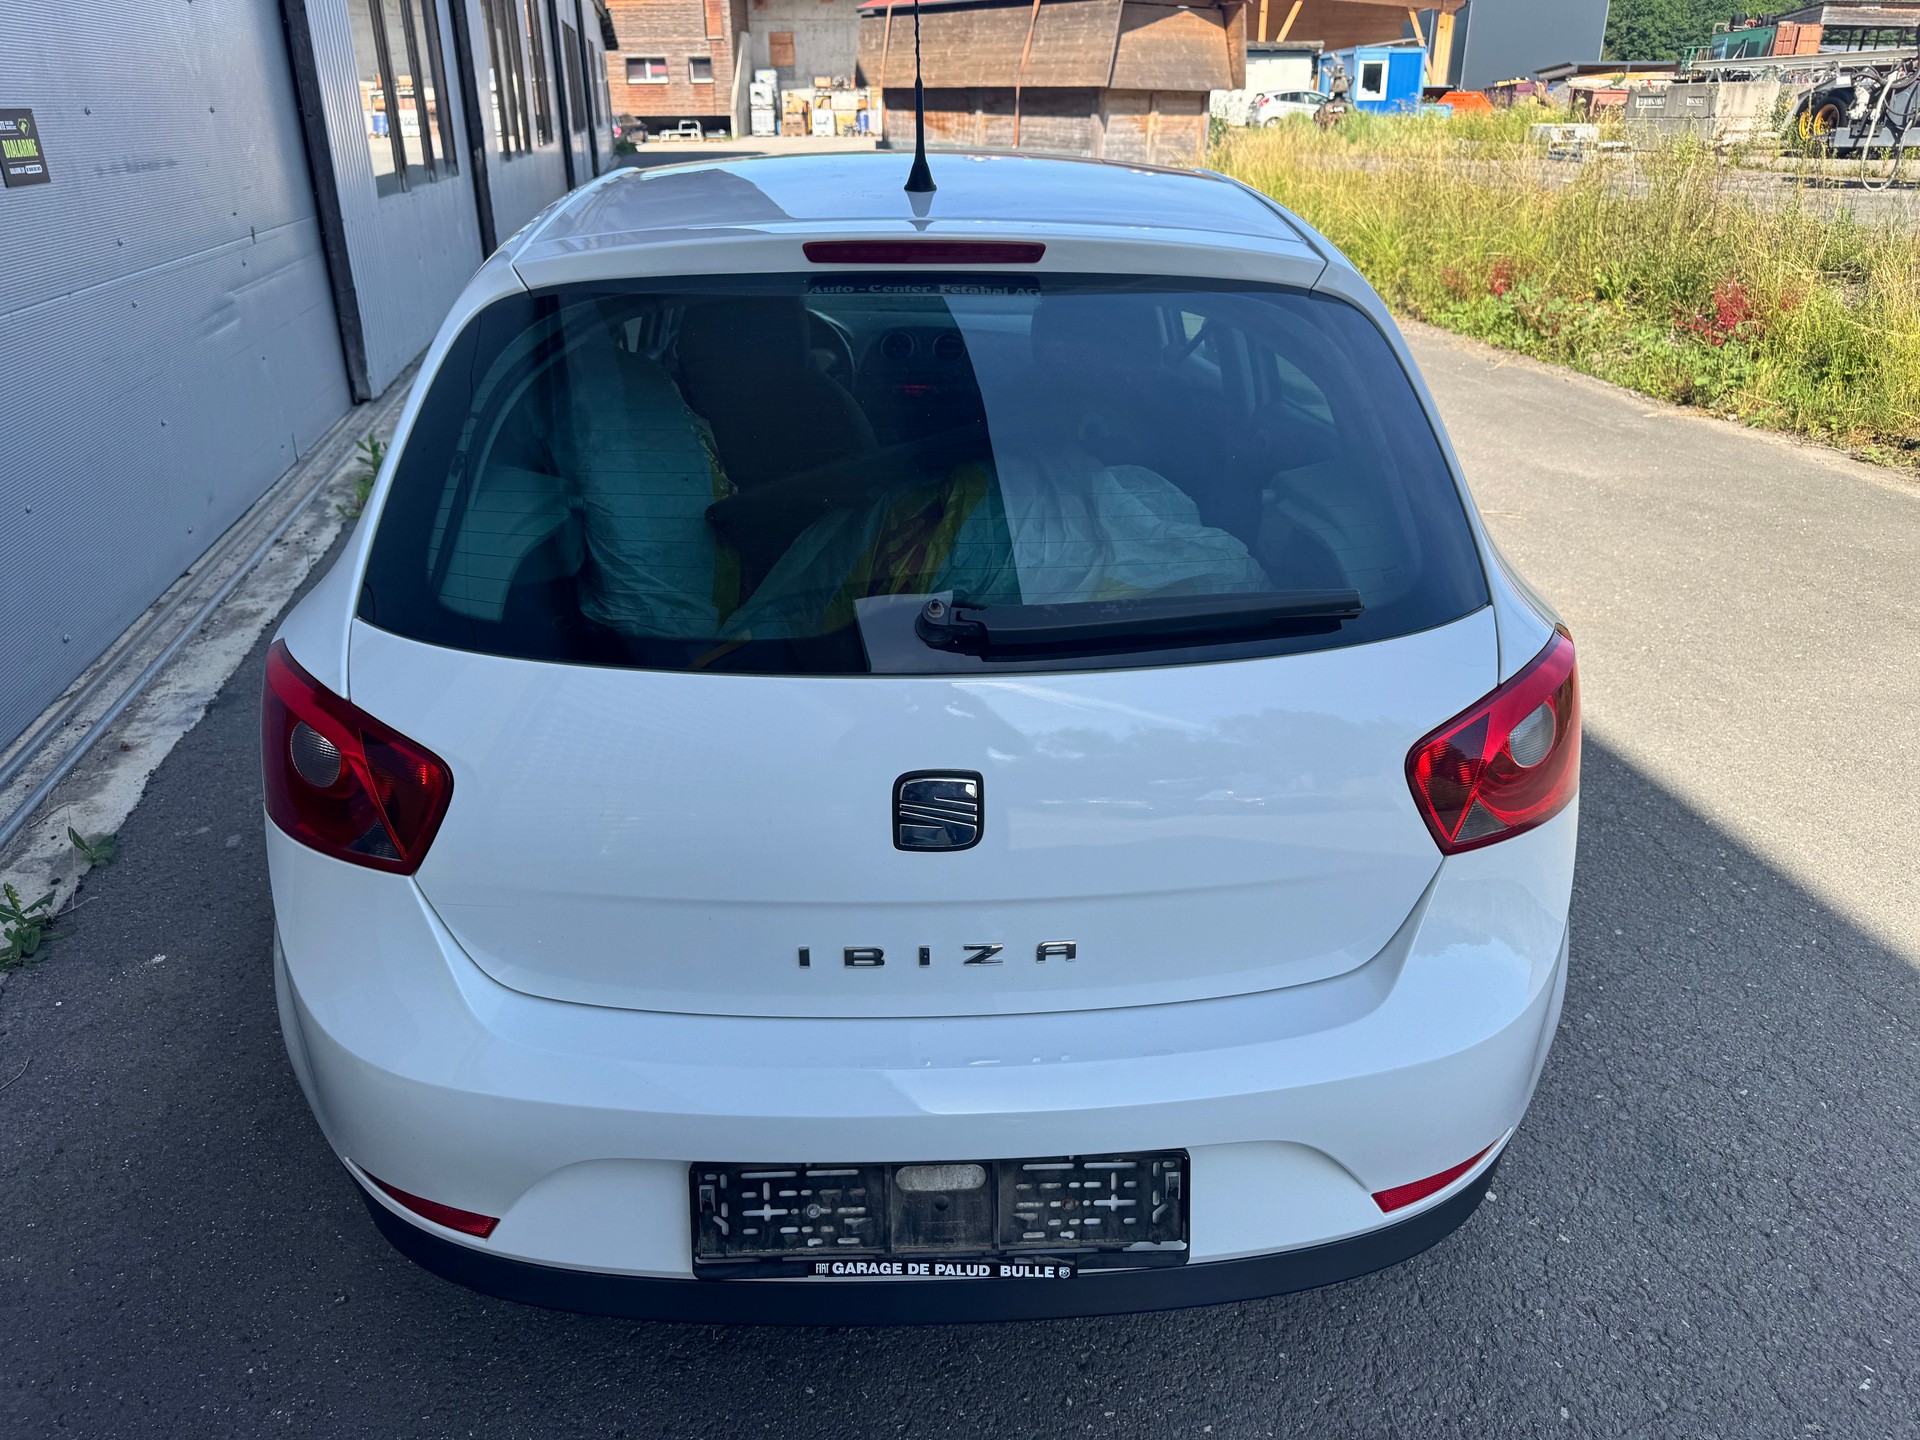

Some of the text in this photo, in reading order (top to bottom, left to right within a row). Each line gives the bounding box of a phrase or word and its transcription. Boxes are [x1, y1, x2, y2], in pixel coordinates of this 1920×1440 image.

[798, 939, 1077, 968] IBIZA
[832, 1262, 903, 1275] GARAGE
[907, 1263, 930, 1276] DE
[934, 1263, 991, 1277] PALUD
[1000, 1265, 1055, 1278] BULLE
